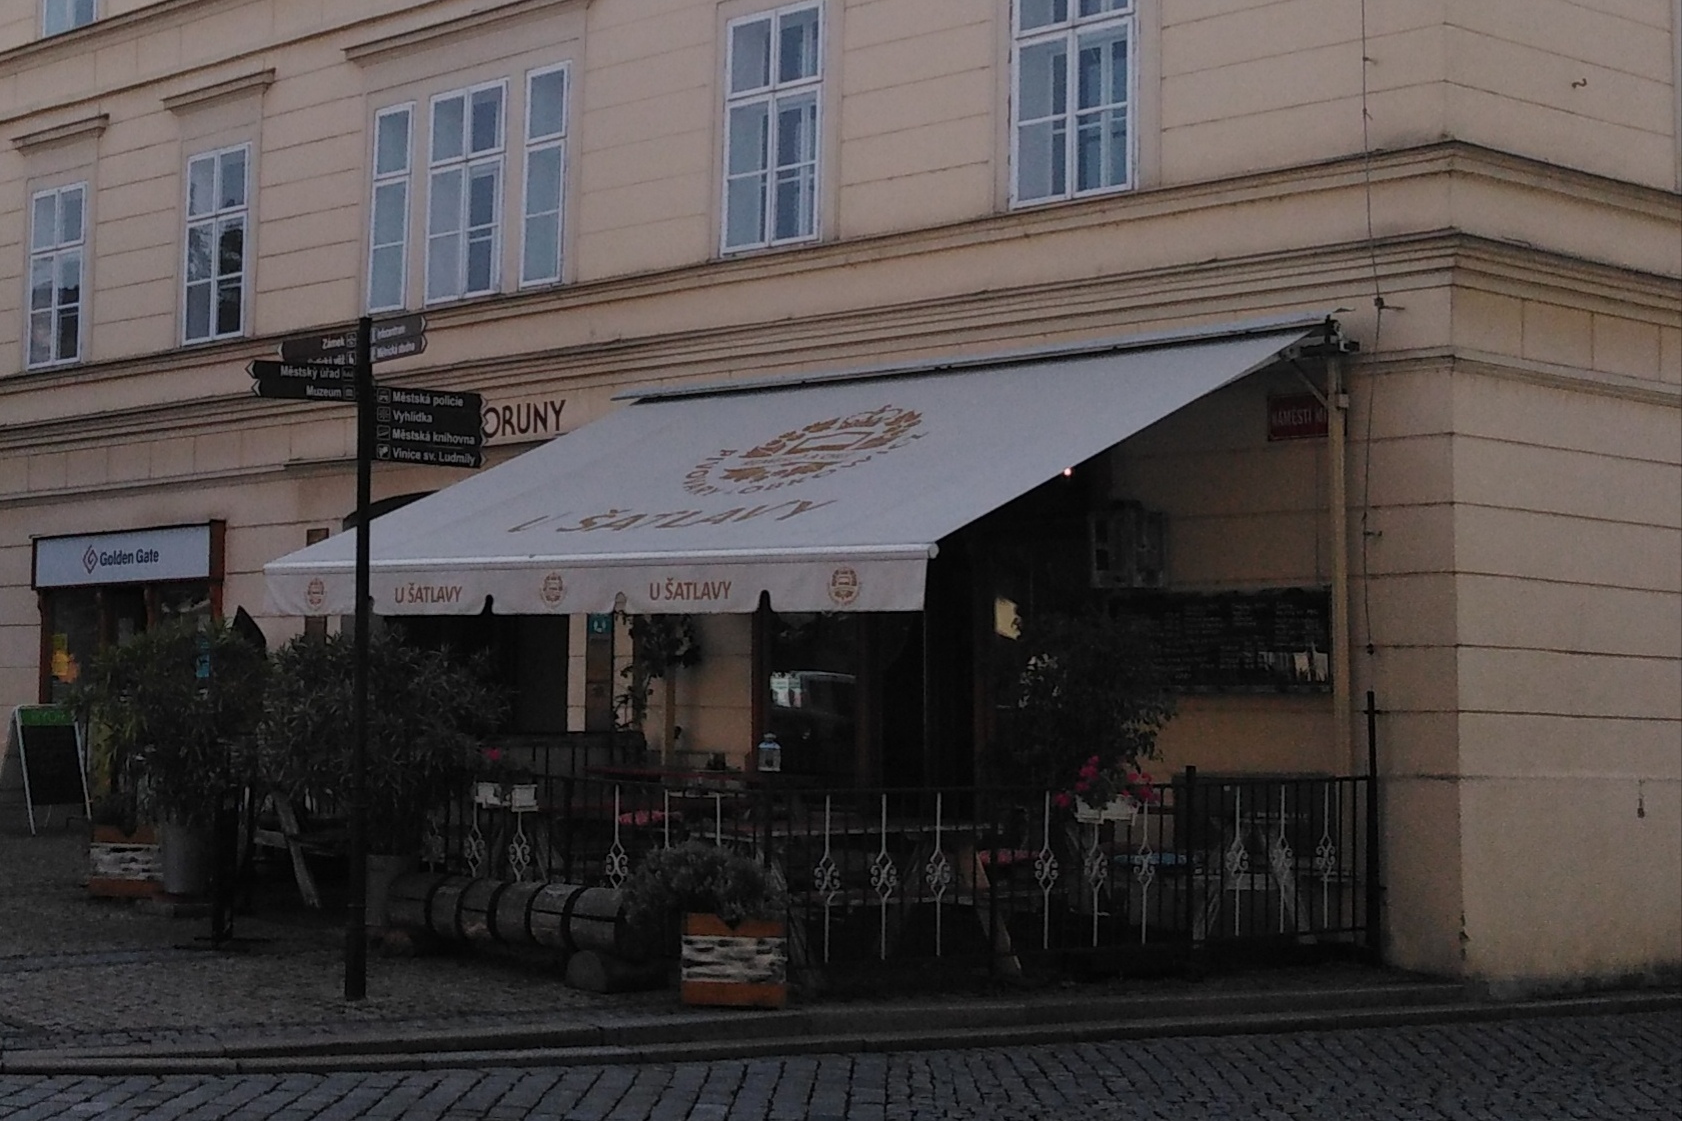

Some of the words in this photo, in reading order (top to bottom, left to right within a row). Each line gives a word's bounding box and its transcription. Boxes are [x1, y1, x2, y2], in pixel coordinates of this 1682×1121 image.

[322, 335, 345, 350] Zámek
[280, 364, 318, 380] Městský
[320, 367, 340, 379] úřad
[305, 385, 342, 398] Muzeum
[391, 390, 431, 405] Městská
[433, 395, 464, 407] policie
[392, 410, 433, 424] Vyhlídka
[482, 399, 566, 438] ORUNY
[391, 428, 431, 442] Městská
[433, 431, 475, 444] knihovna
[392, 447, 422, 460] Vinice
[424, 452, 436, 461] sv.
[439, 451, 476, 466] Ludmily
[556, 499, 839, 532] ŠATLAVY
[99, 550, 134, 567] Golden
[136, 548, 159, 564] Gate
[394, 588, 404, 604] U
[408, 583, 463, 604] ŠATLAVY
[648, 582, 660, 601] U
[664, 577, 732, 601] ŠATLAVY
